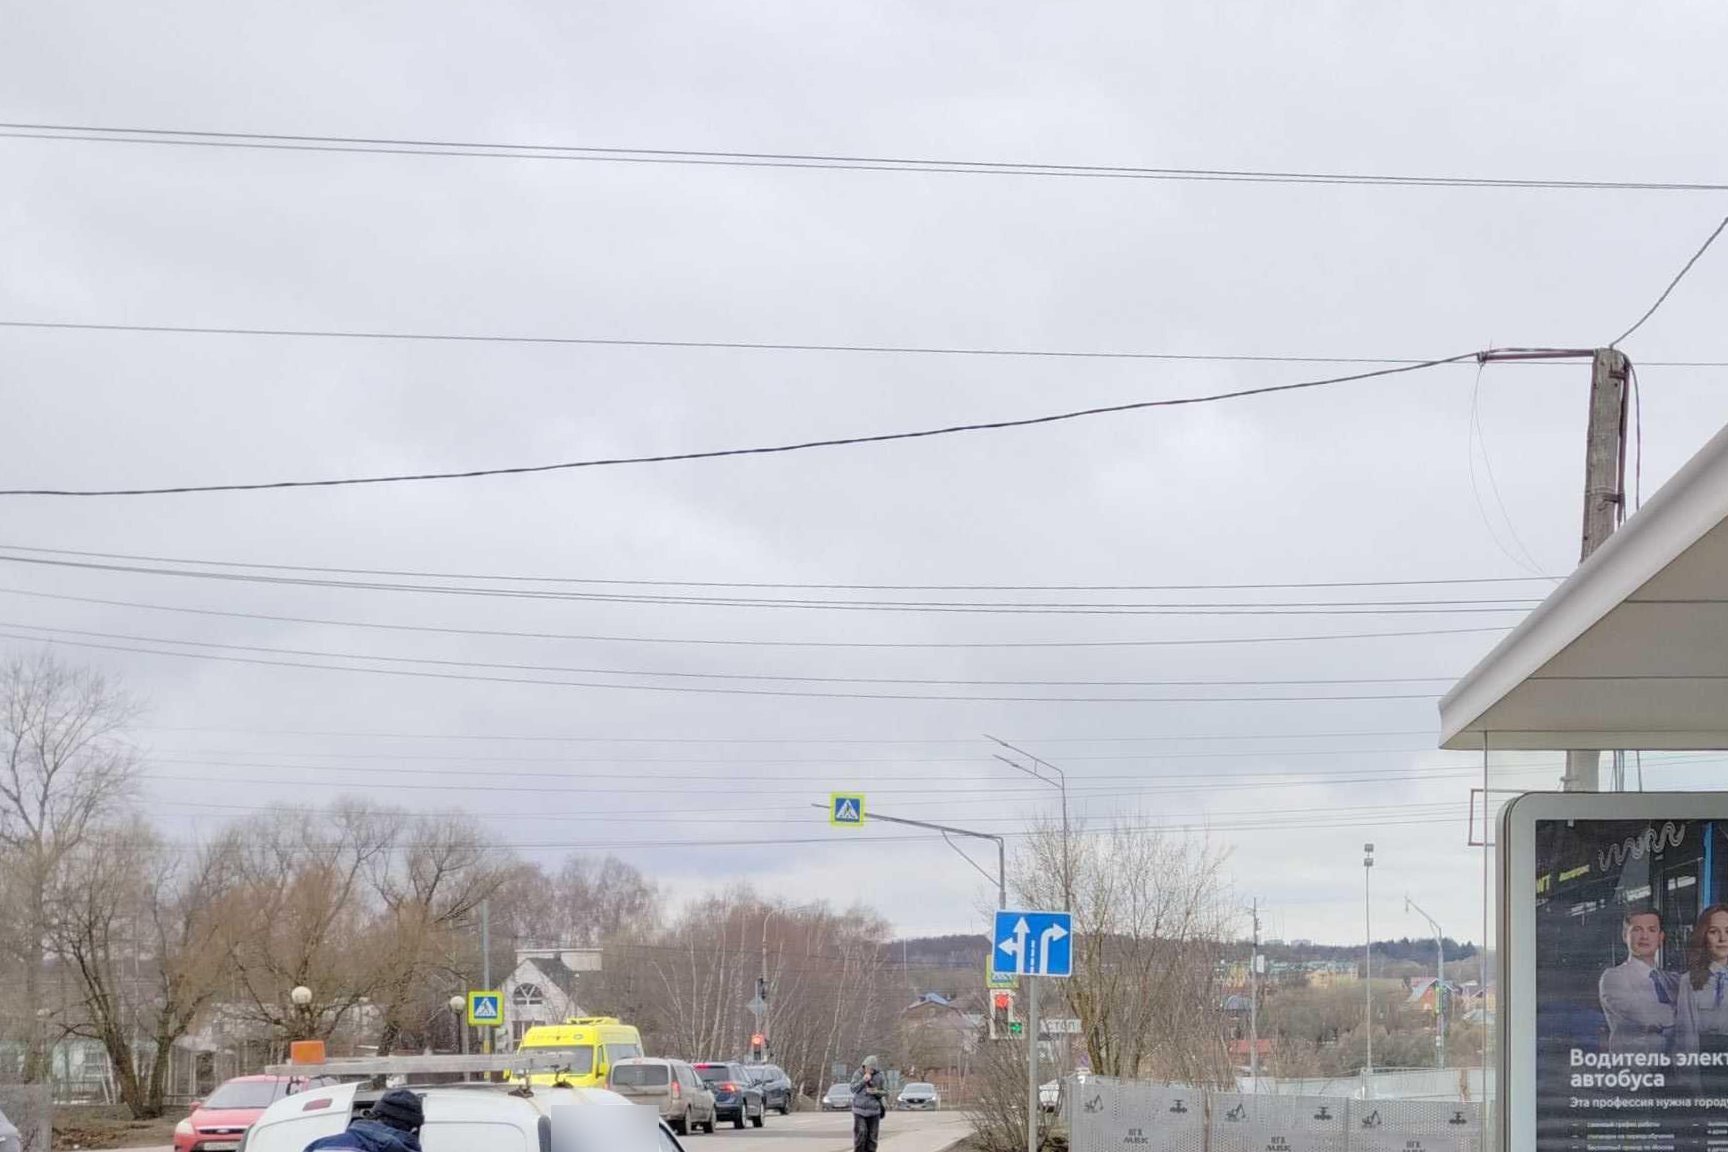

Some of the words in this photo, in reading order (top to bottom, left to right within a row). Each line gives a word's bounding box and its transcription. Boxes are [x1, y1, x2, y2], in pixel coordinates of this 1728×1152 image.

[1570, 1048, 1671, 1069] Водитель
[1570, 1069, 1665, 1091] автобуса
[1569, 1097, 1589, 1108] Эта
[1592, 1096, 1654, 1109] профессия
[1656, 1097, 1692, 1109] нужна
